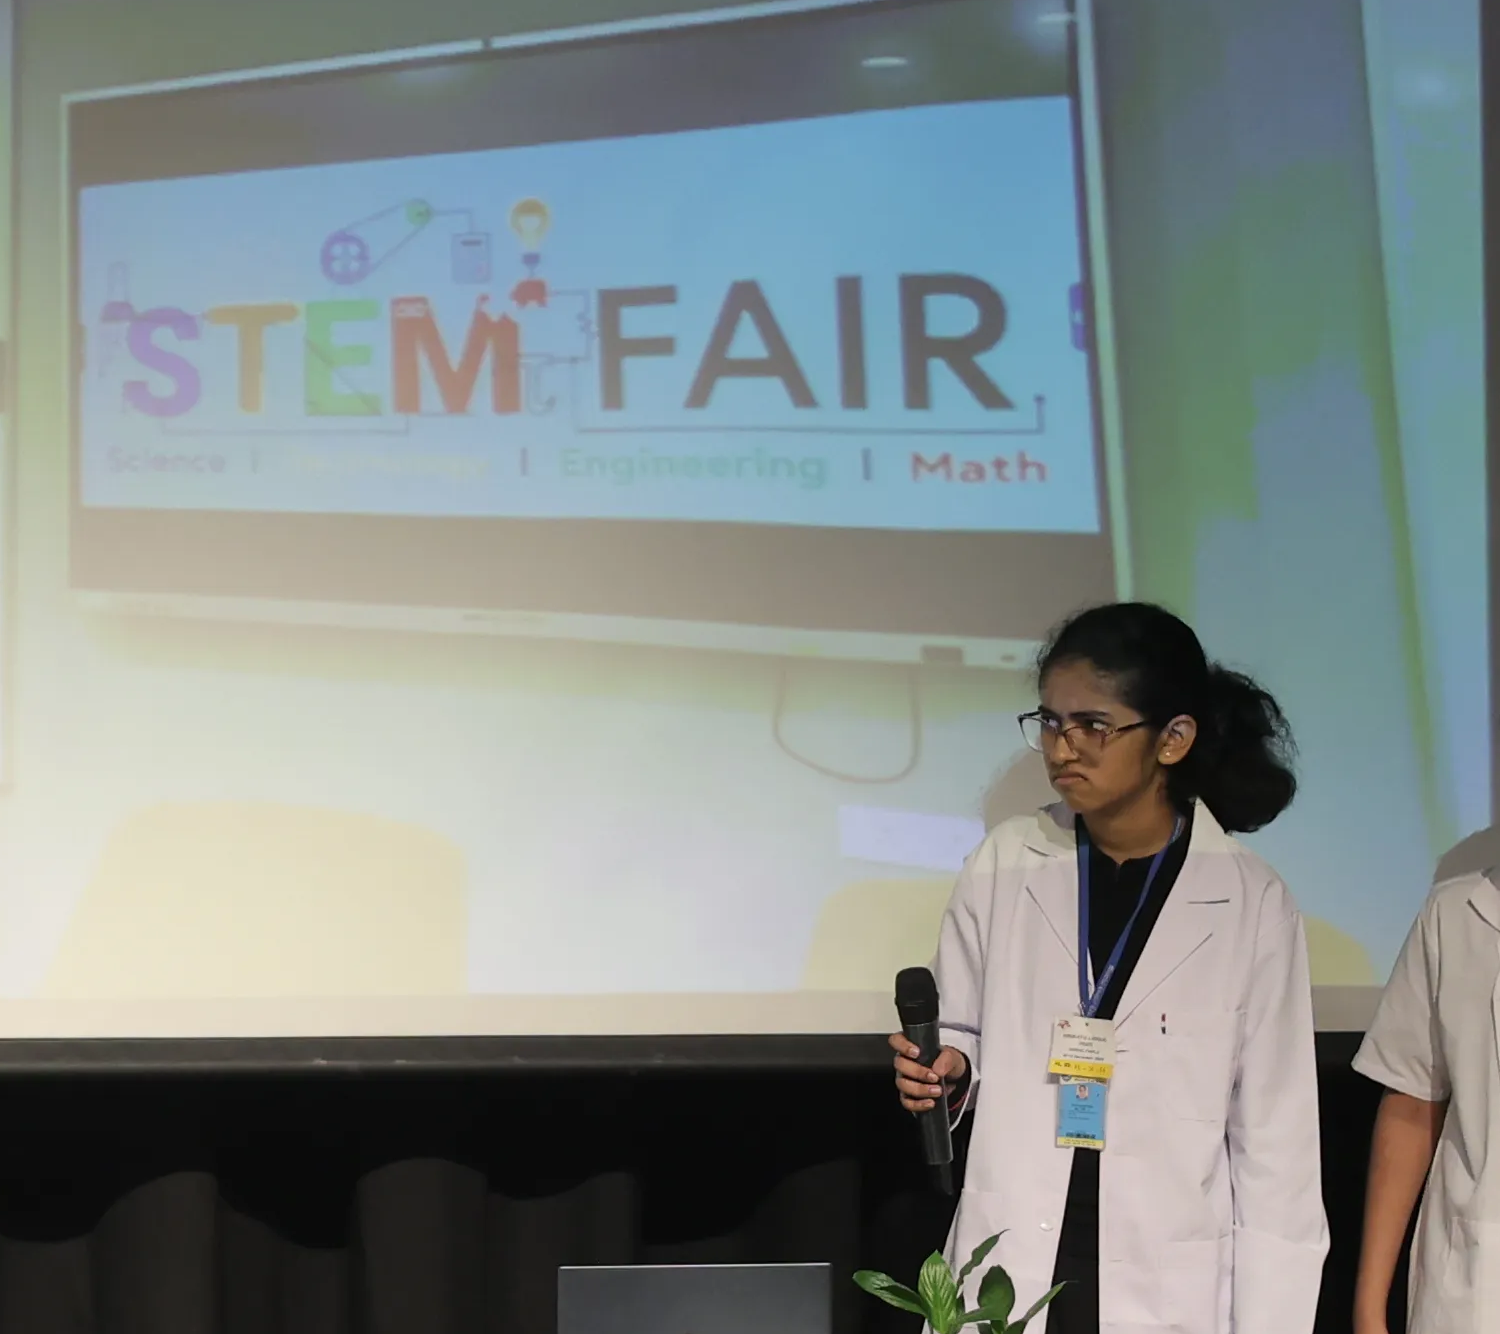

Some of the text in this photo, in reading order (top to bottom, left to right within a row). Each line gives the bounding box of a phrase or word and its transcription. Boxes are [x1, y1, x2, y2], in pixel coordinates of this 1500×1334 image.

[123, 271, 1016, 417] STEM FAIR
[559, 446, 827, 491] Engineering
[910, 448, 1048, 485] Math
